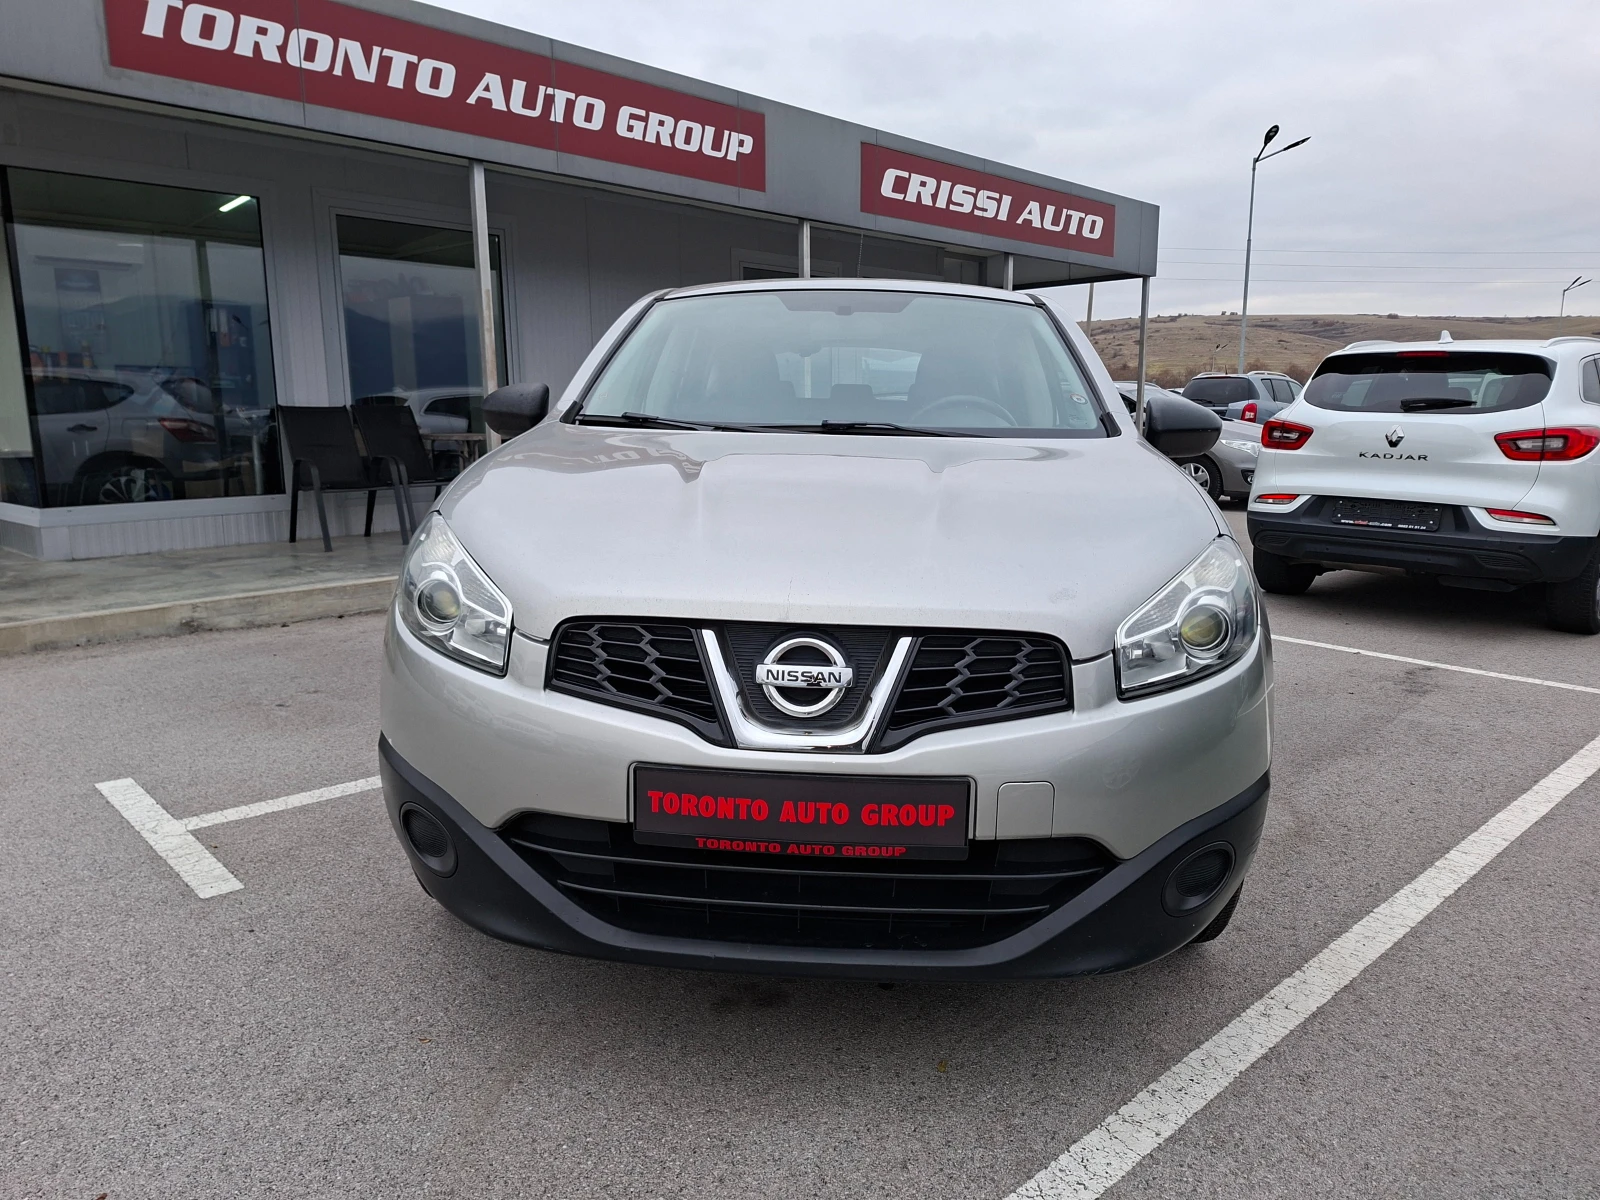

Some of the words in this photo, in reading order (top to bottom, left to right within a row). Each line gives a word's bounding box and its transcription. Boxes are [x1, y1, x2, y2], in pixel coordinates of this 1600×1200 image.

[141, 0, 456, 99] TORONTO
[466, 72, 605, 131] AUTO
[616, 107, 754, 162] GROUP
[880, 168, 1012, 222] CRISSI
[1016, 200, 1104, 240] AUTO
[1359, 451, 1429, 462] KADJAR
[766, 668, 842, 684] NISSAN
[647, 790, 769, 822] TORONTO
[779, 800, 850, 826] AUTO
[861, 803, 955, 827] GROUP
[695, 837, 781, 853] TORONTO
[787, 843, 835, 855] AUTO
[842, 845, 907, 857] GROUP
